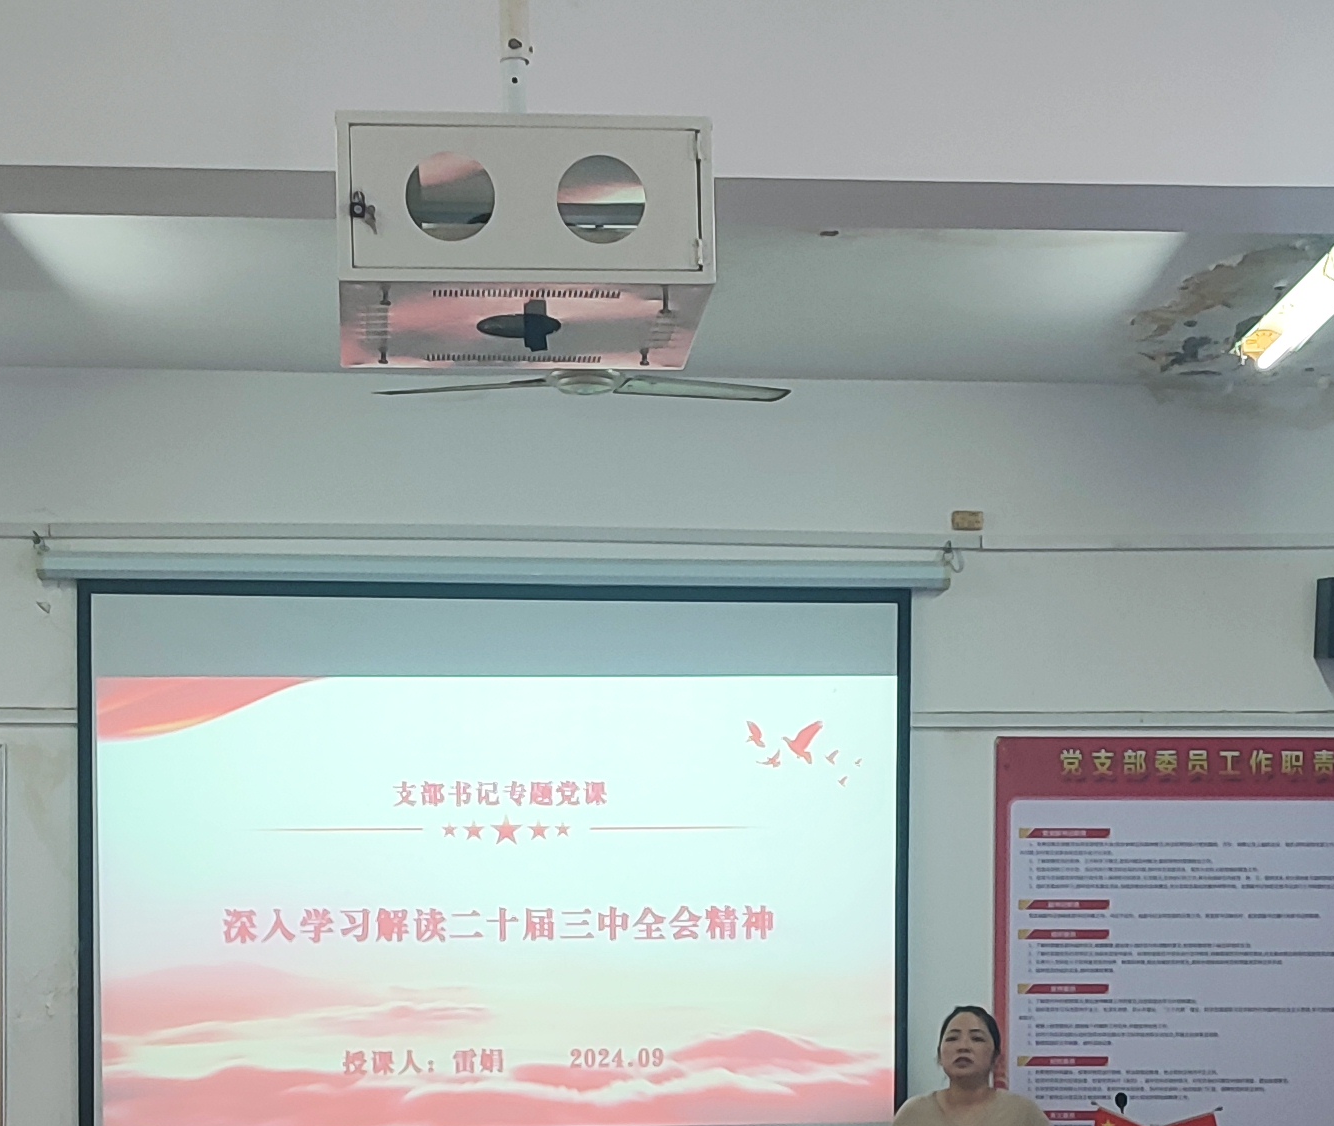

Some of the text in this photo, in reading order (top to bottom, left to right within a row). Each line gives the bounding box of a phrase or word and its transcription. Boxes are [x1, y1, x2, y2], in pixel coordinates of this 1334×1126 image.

[393, 780, 608, 806] 支部书记专题党课
[222, 905, 774, 943] 深入学习解读二十届三中全会精神
[570, 1047, 665, 1069] 2024.09
